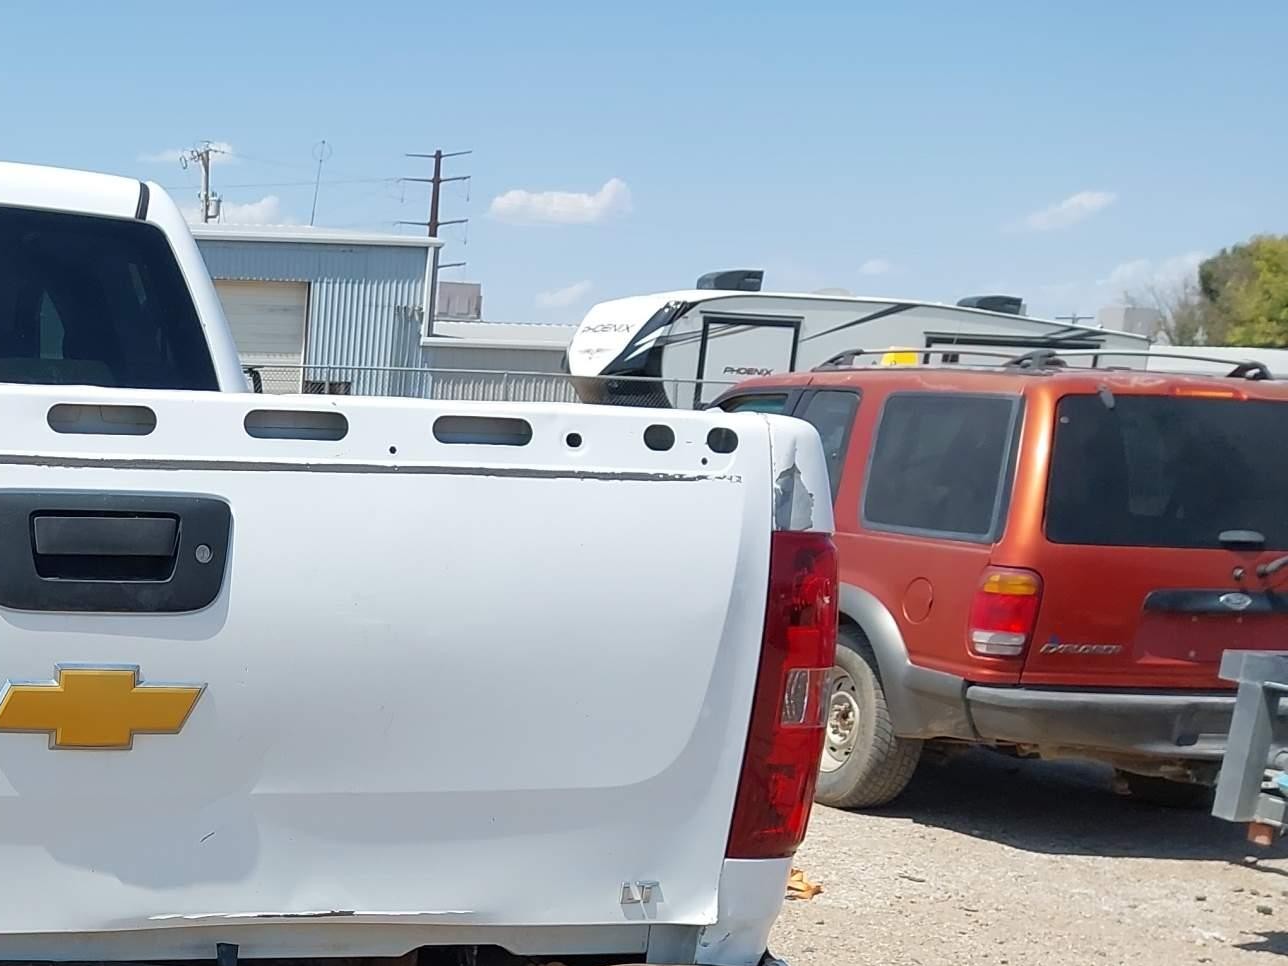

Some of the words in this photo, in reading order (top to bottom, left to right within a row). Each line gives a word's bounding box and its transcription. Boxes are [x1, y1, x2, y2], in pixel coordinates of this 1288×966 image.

[580, 322, 636, 334] PHOENIX
[723, 366, 774, 377] PHOENIX
[619, 880, 660, 905] LT
